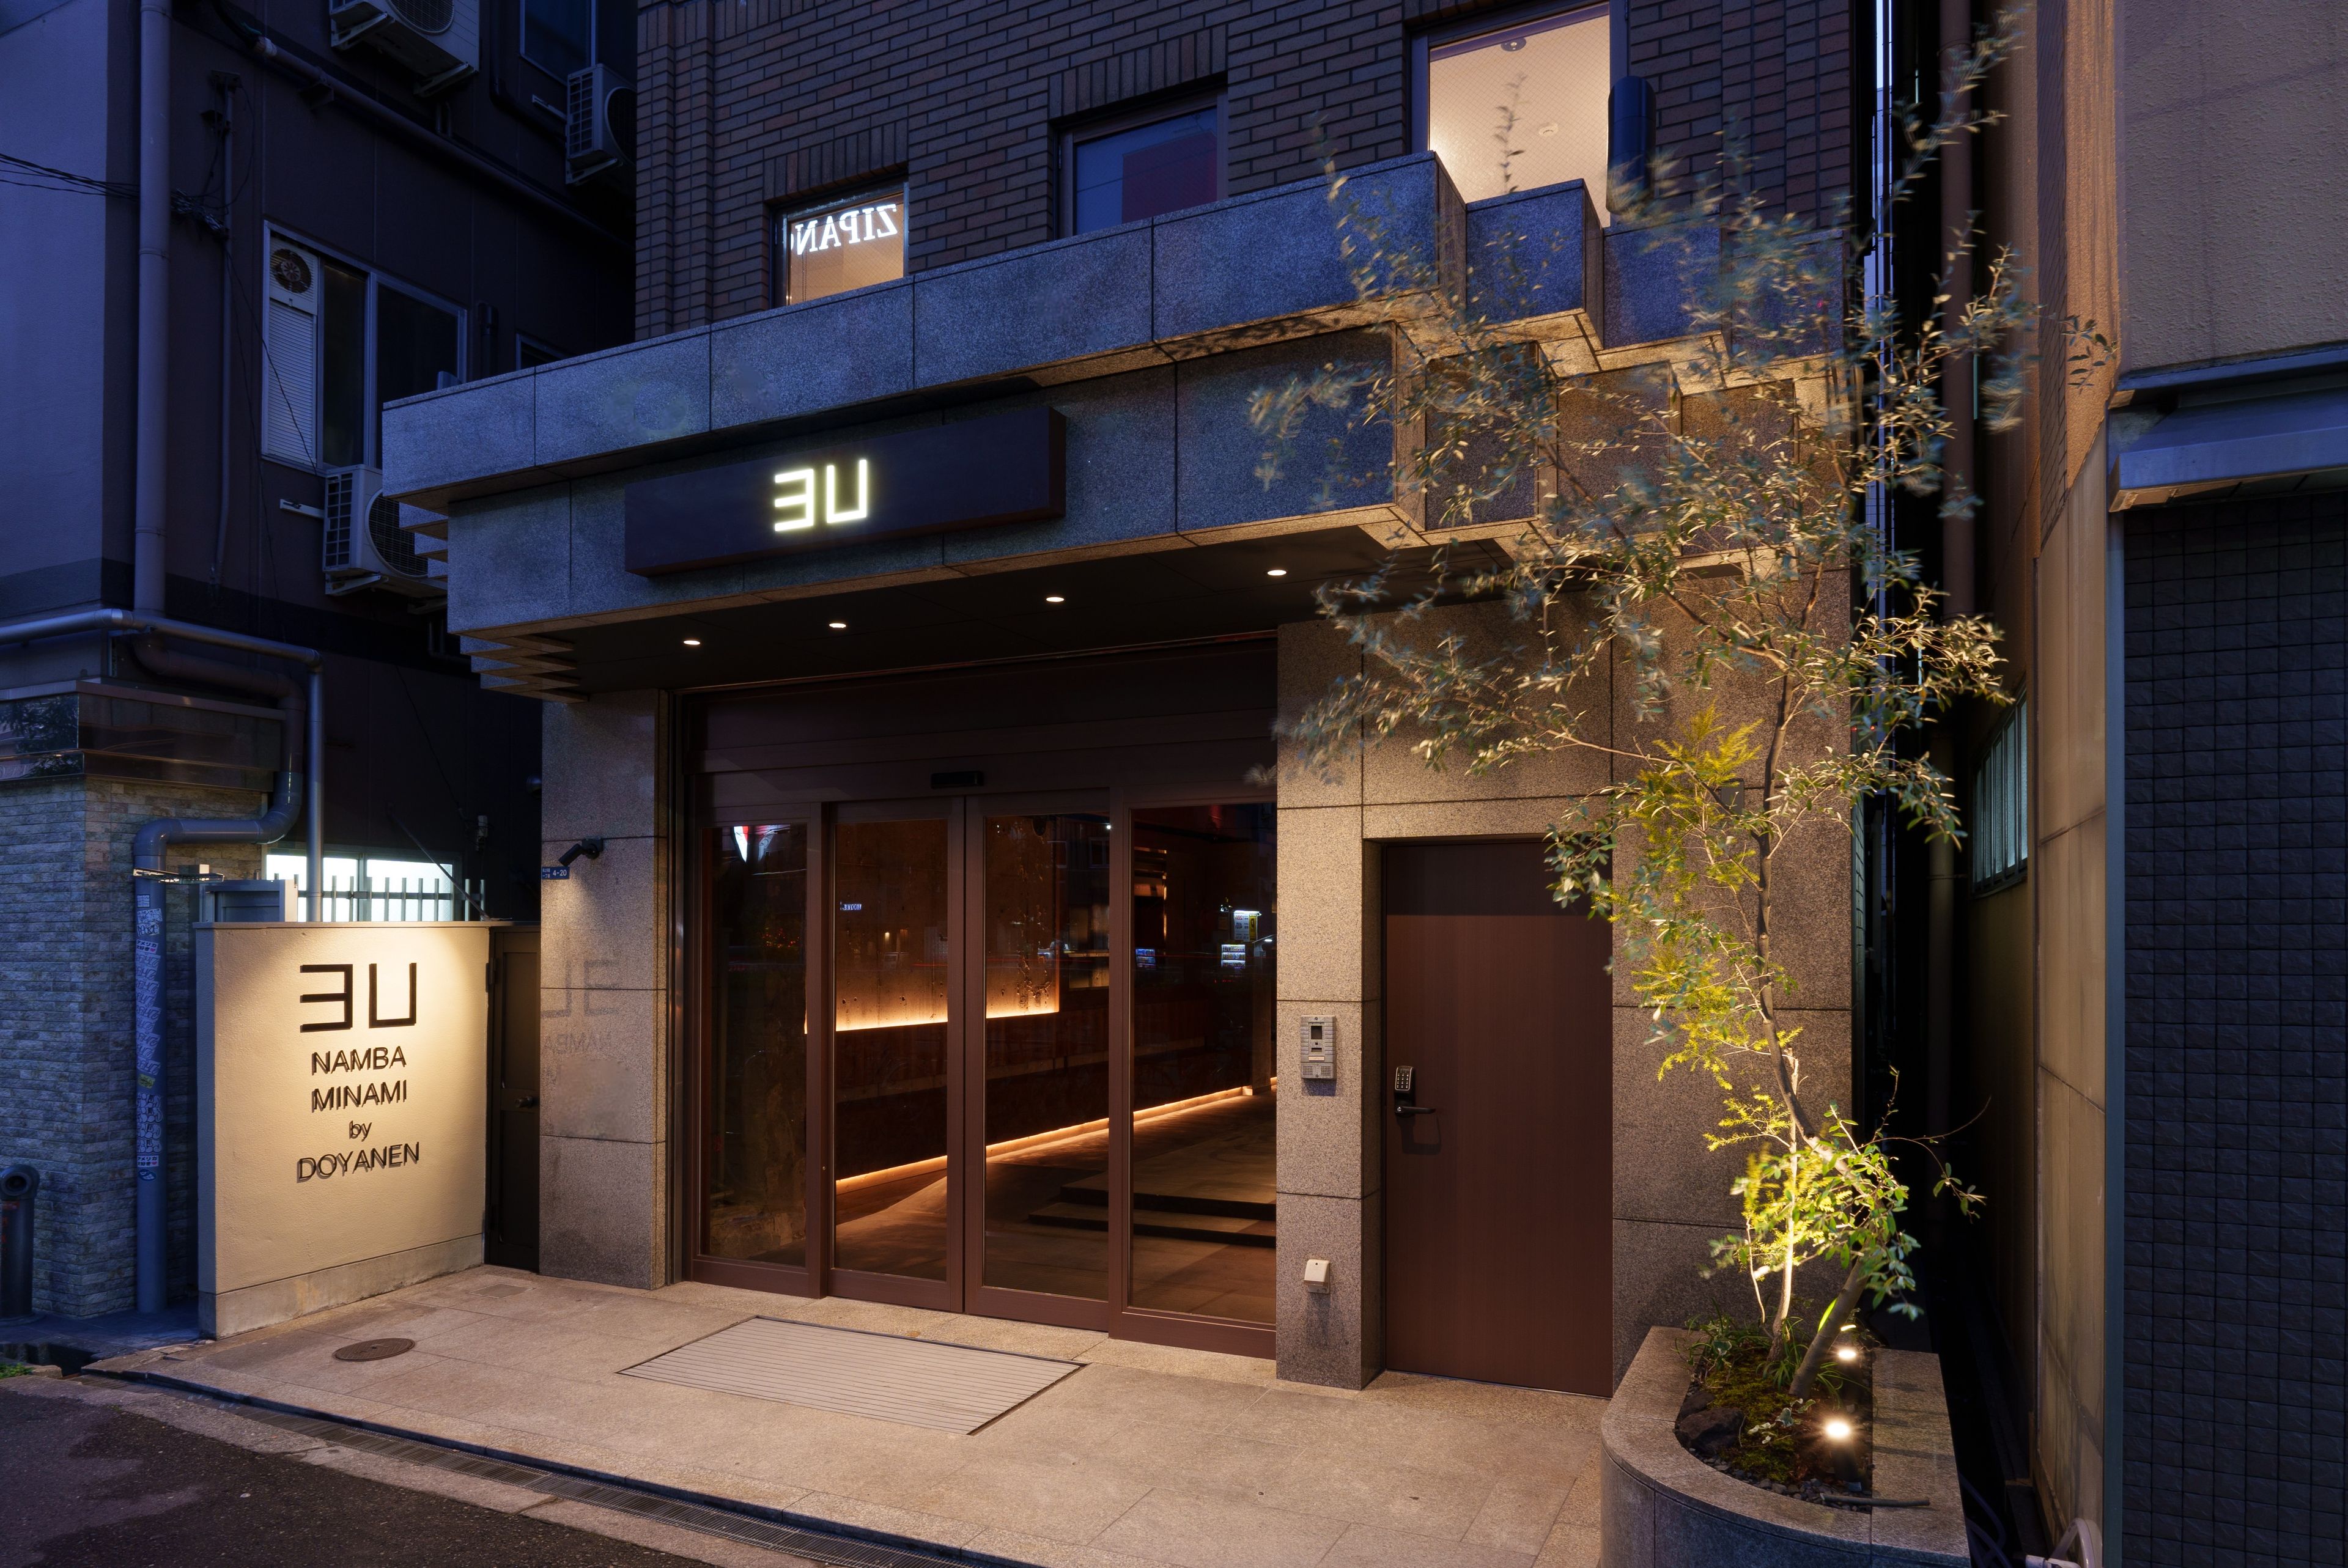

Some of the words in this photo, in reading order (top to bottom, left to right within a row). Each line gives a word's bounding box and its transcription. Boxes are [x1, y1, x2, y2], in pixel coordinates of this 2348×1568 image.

[311, 1046, 407, 1075] NAMBA
[311, 1080, 407, 1113] MINAMI
[349, 1121, 372, 1142] by
[297, 1142, 419, 1183] DOYANEN
